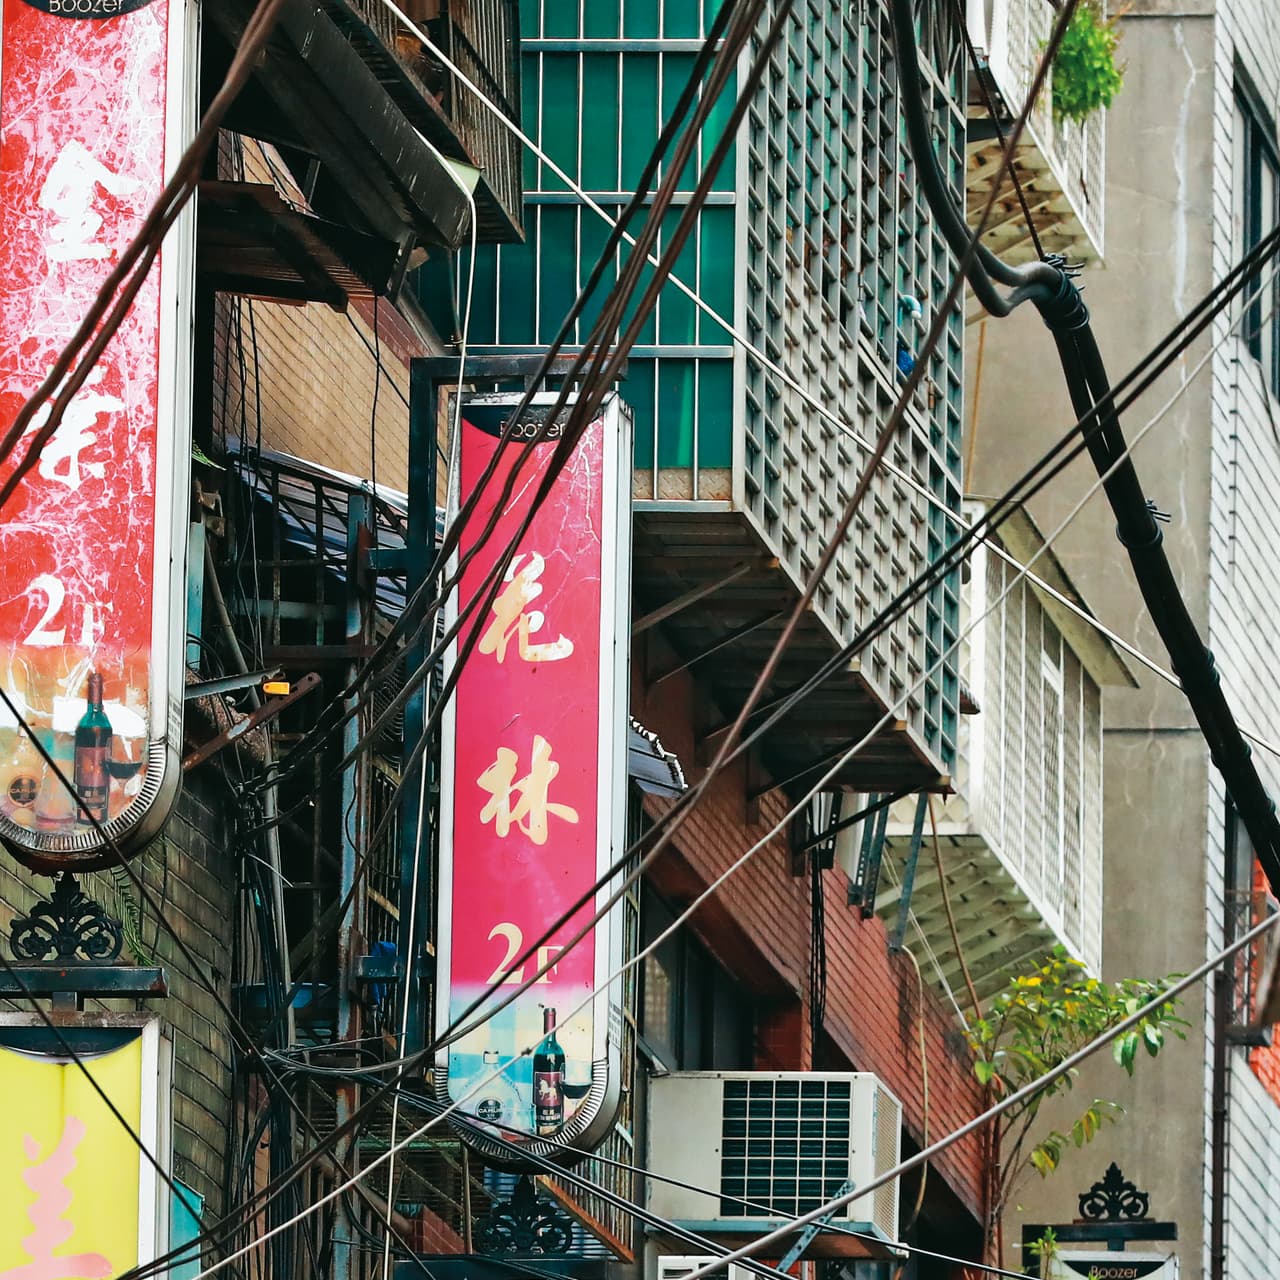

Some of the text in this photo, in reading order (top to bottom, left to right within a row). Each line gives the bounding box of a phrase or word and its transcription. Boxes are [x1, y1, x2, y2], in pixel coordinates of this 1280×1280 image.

[22, 573, 114, 647] 2F
[476, 551, 579, 846] 花林
[486, 921, 560, 985] 2F
[1090, 1264, 1138, 1280] Boozer
